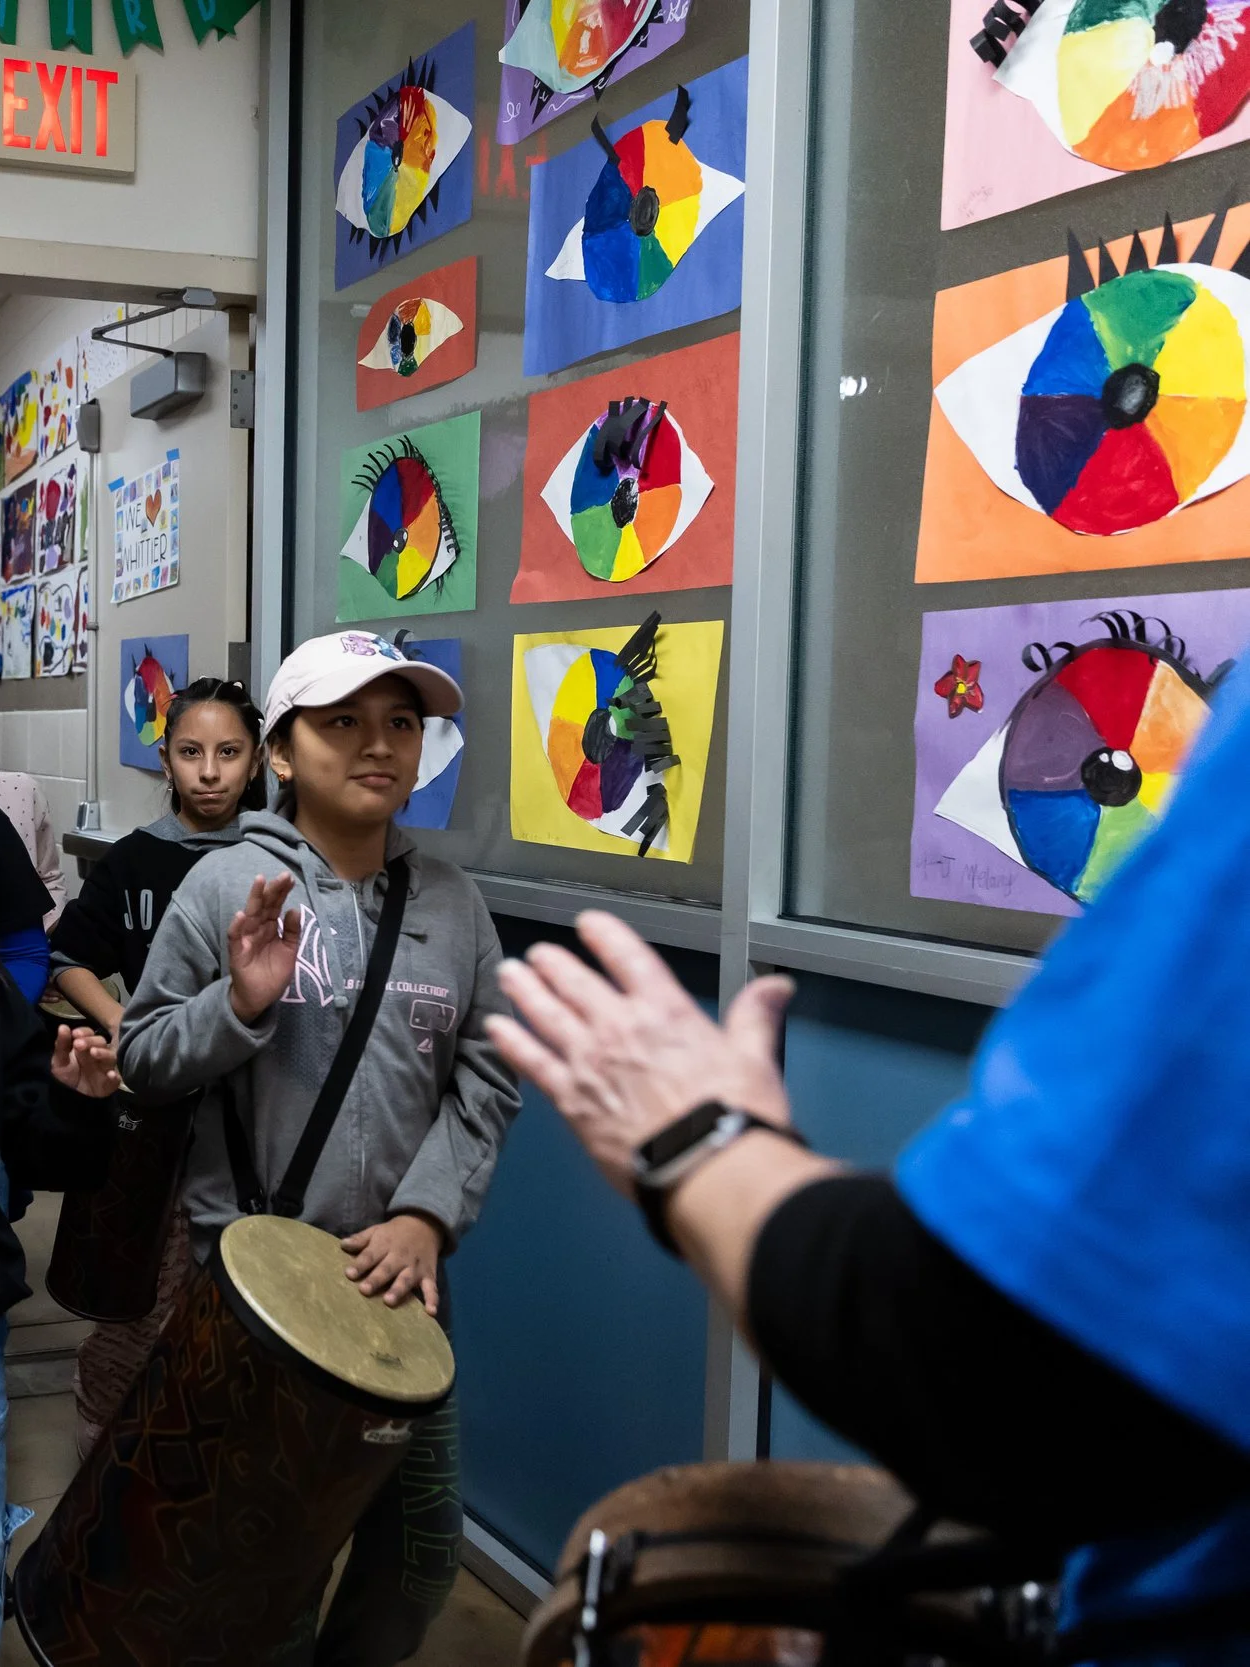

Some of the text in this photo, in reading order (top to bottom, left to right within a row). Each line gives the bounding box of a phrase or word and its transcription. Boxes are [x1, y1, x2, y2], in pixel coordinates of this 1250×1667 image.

[2, 57, 118, 157] EXIT
[125, 503, 142, 531] WE
[122, 533, 168, 572] WHITTIER
[397, 981, 447, 998] COLLECTION
